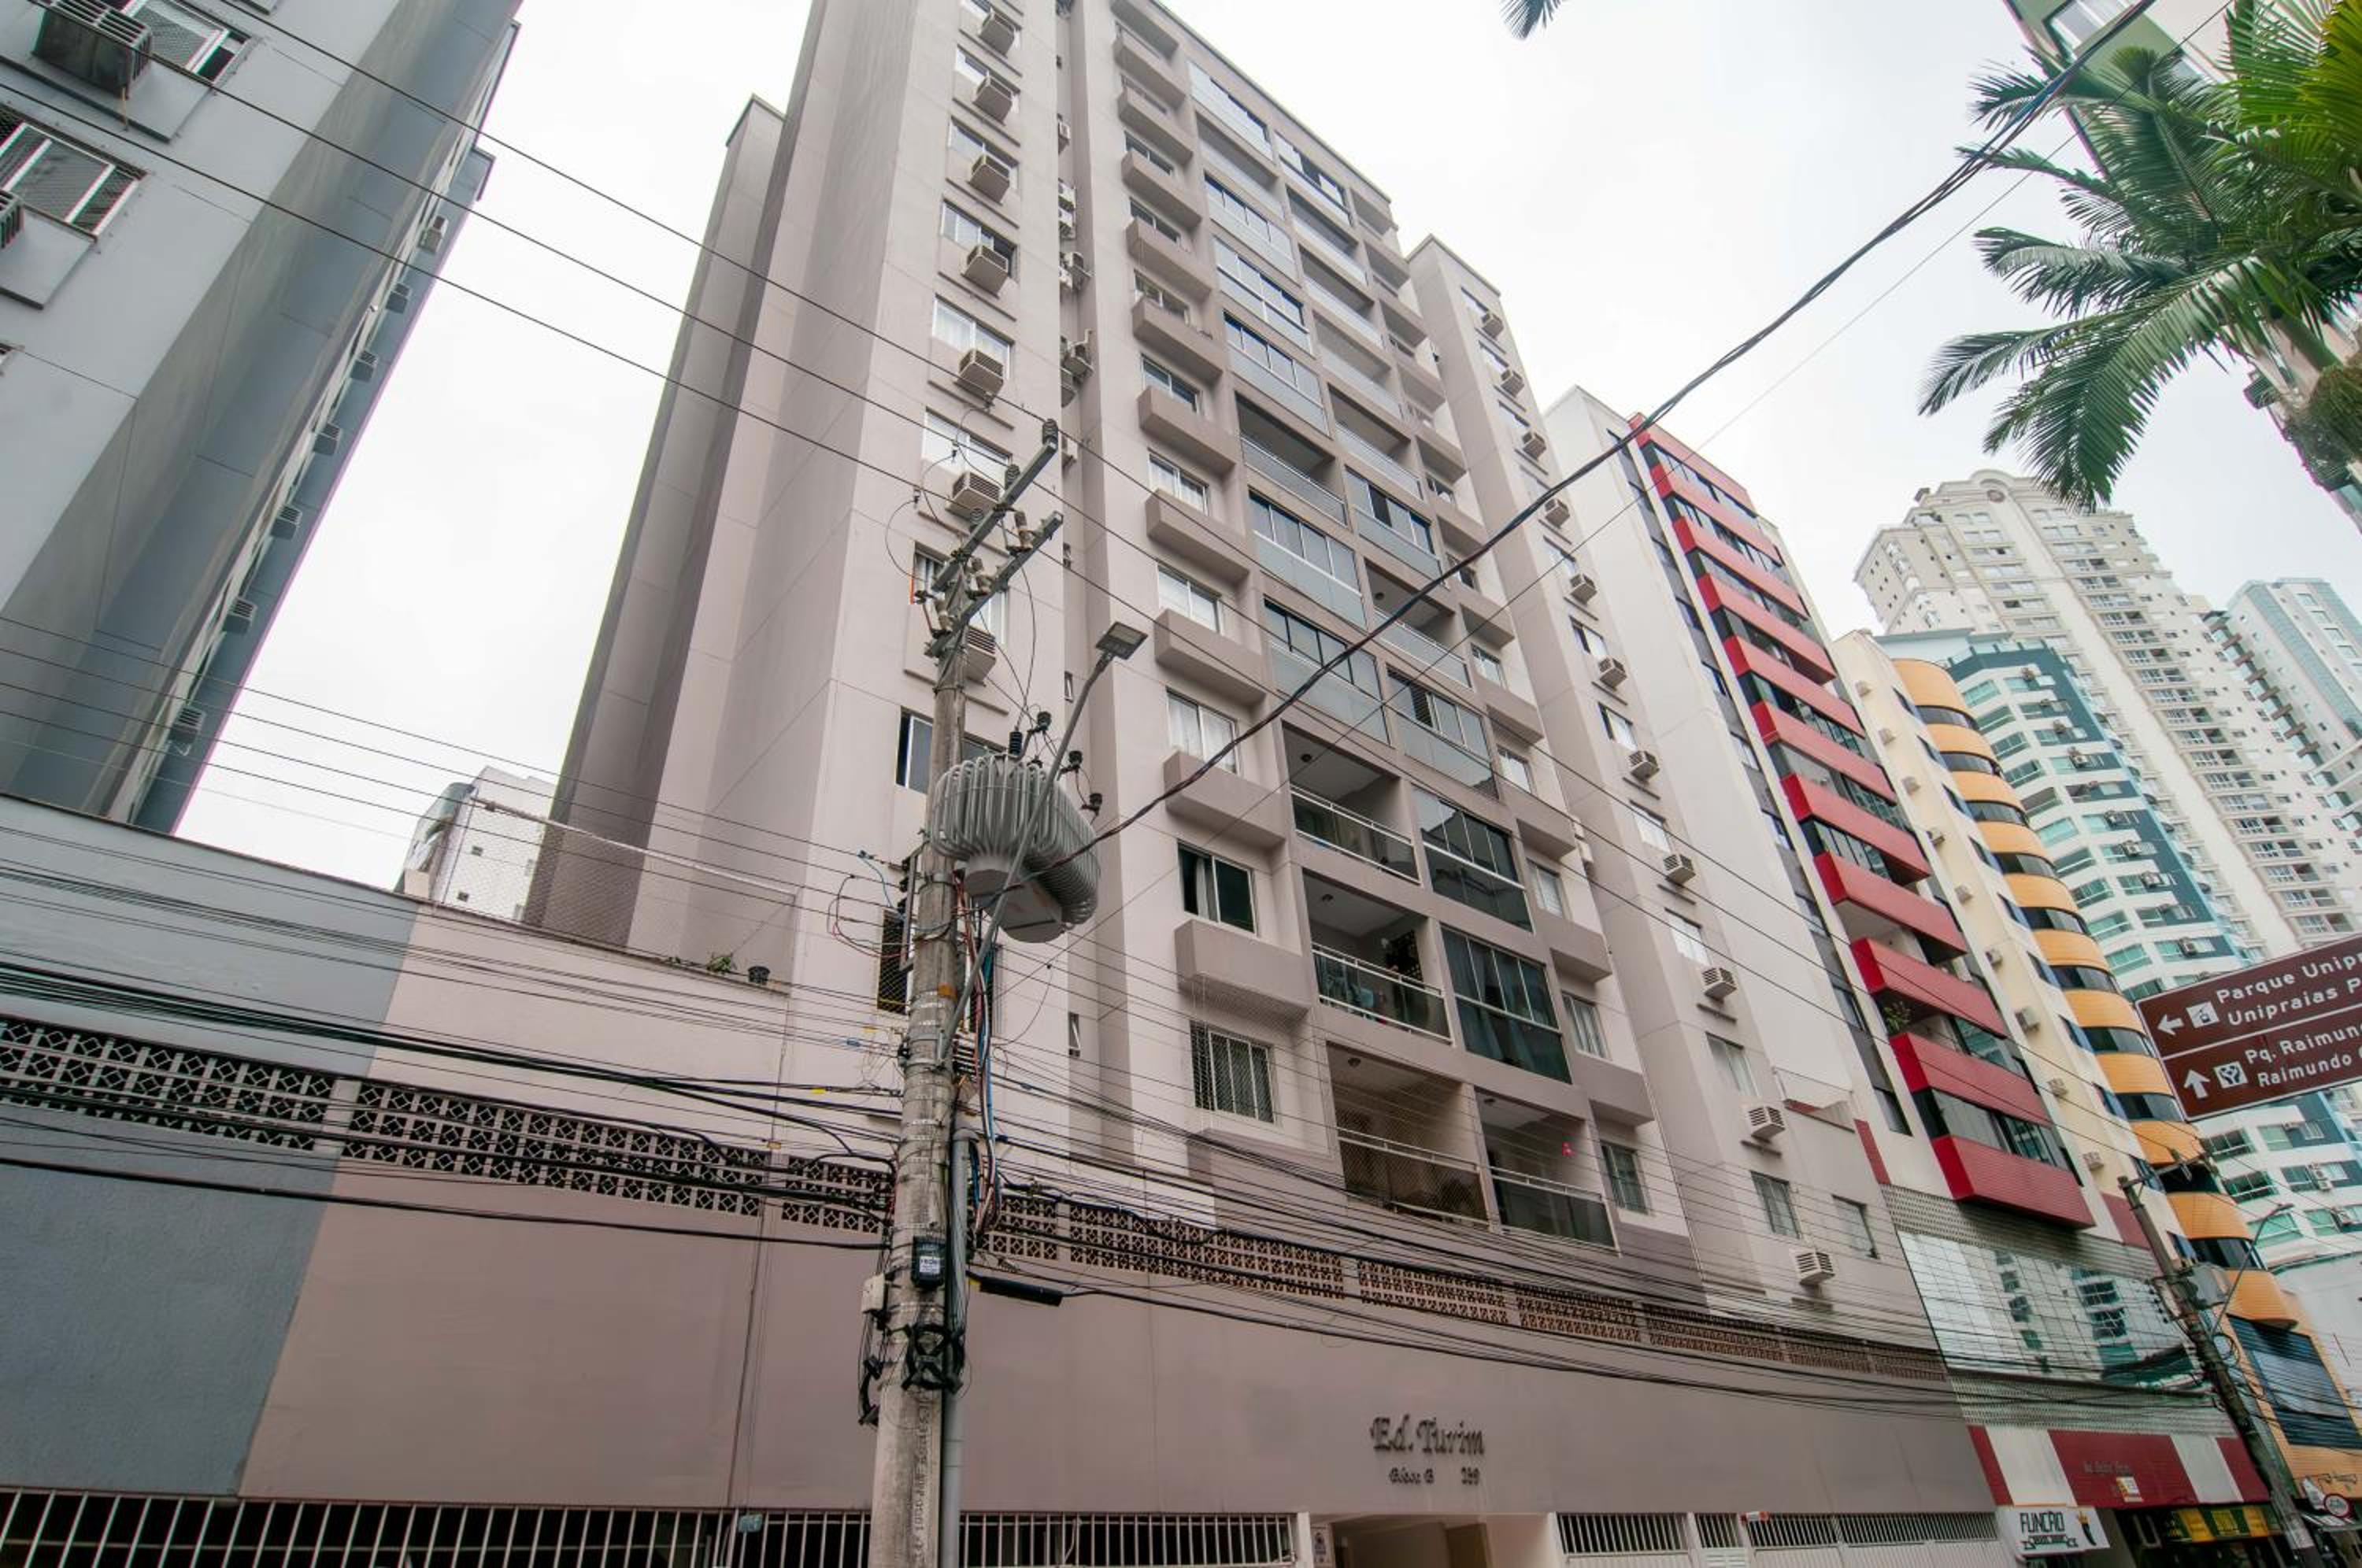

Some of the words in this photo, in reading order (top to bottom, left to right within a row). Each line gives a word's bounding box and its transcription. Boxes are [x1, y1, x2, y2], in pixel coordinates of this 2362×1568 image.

[2216, 973, 2295, 1004] Parque
[2228, 987, 2338, 1026] Unipraias
[2245, 1048, 2277, 1063] Pq.
[2257, 1052, 2352, 1087] Raimundo
[1370, 1415, 1414, 1452] Ed.
[1416, 1418, 1484, 1455] Turim
